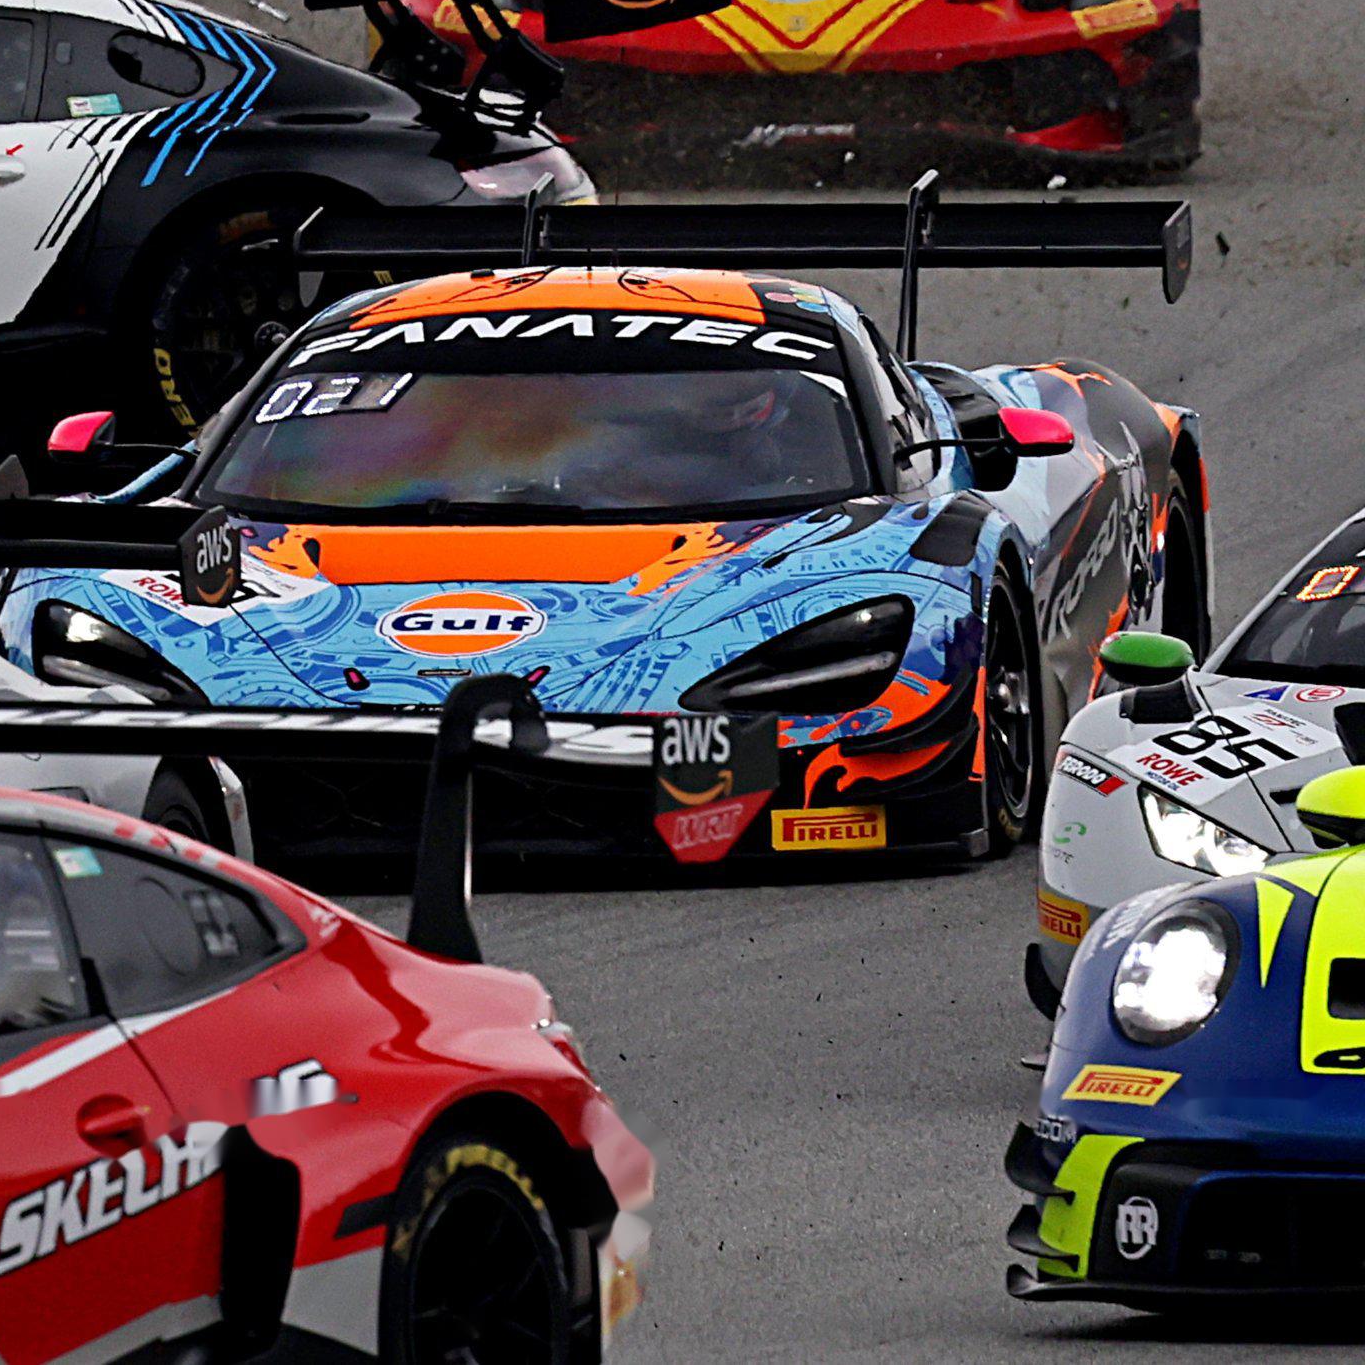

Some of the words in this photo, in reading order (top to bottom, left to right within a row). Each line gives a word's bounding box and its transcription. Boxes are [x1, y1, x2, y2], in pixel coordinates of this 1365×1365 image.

[288, 314, 835, 368] FANATEC
[255, 372, 413, 425] 021
[196, 523, 233, 574] aws
[134, 575, 190, 608] ROW
[391, 610, 534, 634] Gulf
[661, 714, 731, 766] aws
[1152, 714, 1299, 779] 85
[1060, 756, 1108, 785] FERODO
[1136, 752, 1205, 787] ROWE
[782, 813, 878, 842] PIRELLI
[1077, 1071, 1164, 1098] PIRELLI
